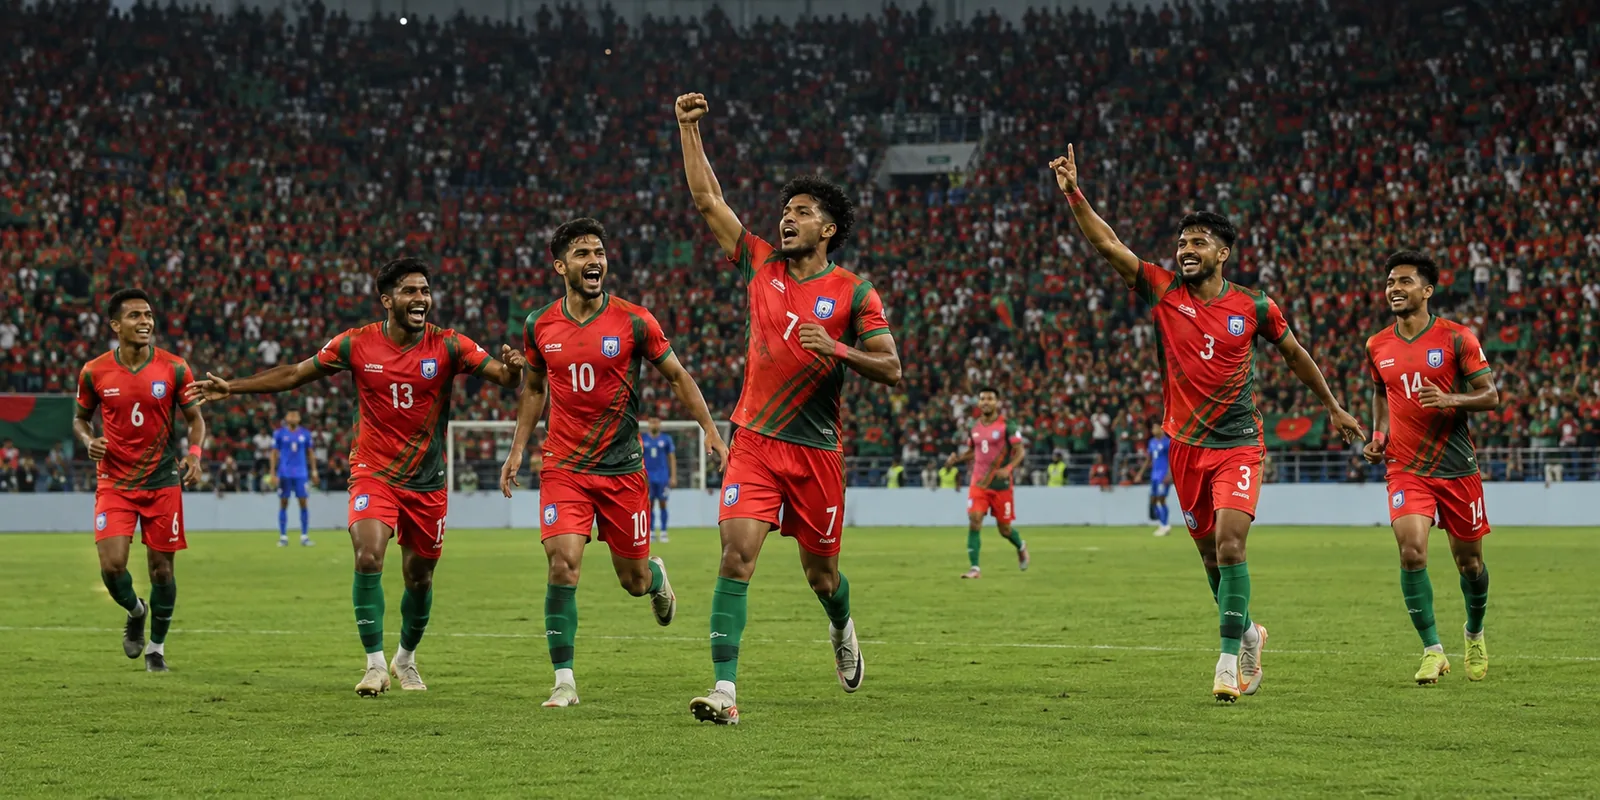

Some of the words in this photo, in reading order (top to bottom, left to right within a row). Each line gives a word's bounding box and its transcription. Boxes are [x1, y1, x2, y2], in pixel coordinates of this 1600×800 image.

[783, 311, 799, 340] 7
[1200, 333, 1215, 360] 3
[568, 363, 595, 392] 10
[1400, 371, 1422, 399] 14
[389, 383, 413, 409] 13
[131, 402, 144, 427] 6
[1237, 465, 1251, 491] 3
[172, 512, 179, 535] 6
[631, 510, 647, 540] 10
[825, 505, 837, 536] 7
[1469, 497, 1483, 525] 14
